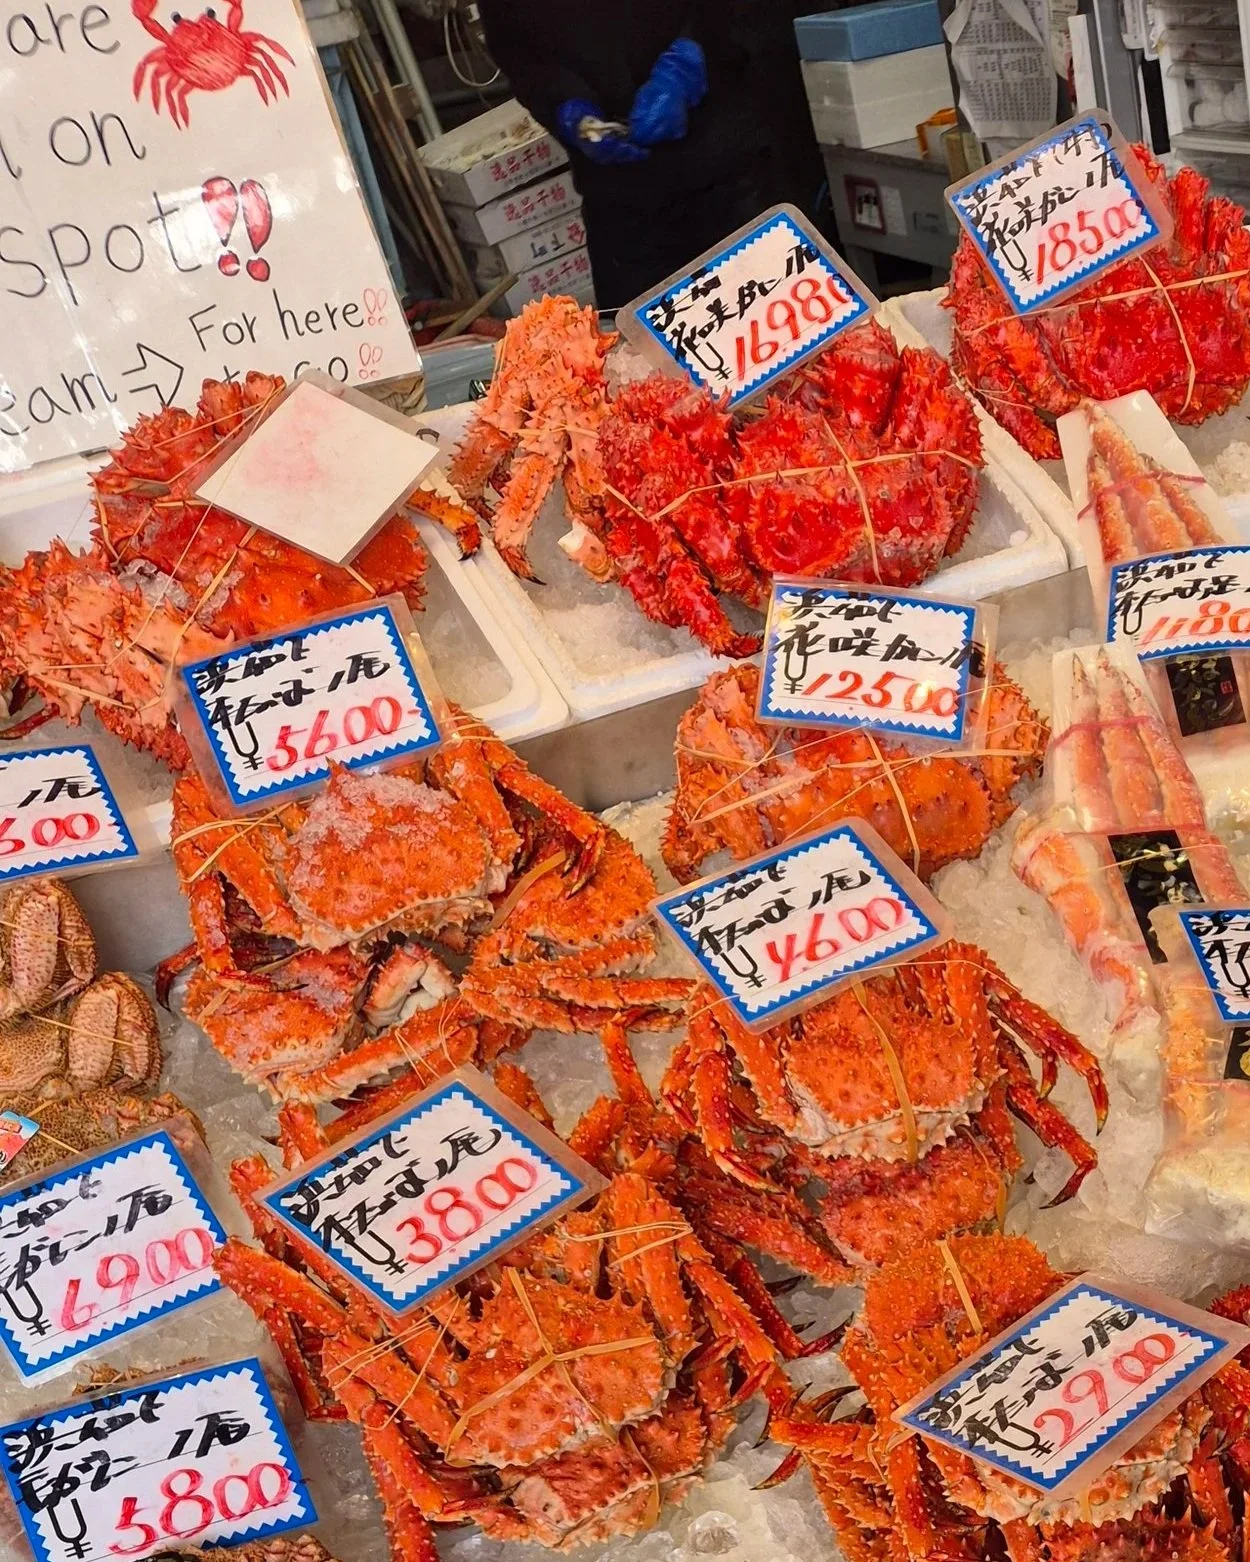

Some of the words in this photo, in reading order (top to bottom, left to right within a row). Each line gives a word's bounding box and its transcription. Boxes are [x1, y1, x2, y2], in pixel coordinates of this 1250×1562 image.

[6, 2, 121, 58] are
[48, 107, 147, 170] on
[187, 303, 258, 353] For
[715, 893, 906, 990] ¥4600
[345, 1155, 541, 1276] ¥3800
[0, 1226, 214, 1336] ¥6900
[1000, 1329, 1177, 1459] ¥2900
[48, 1460, 293, 1562] ¥5800
